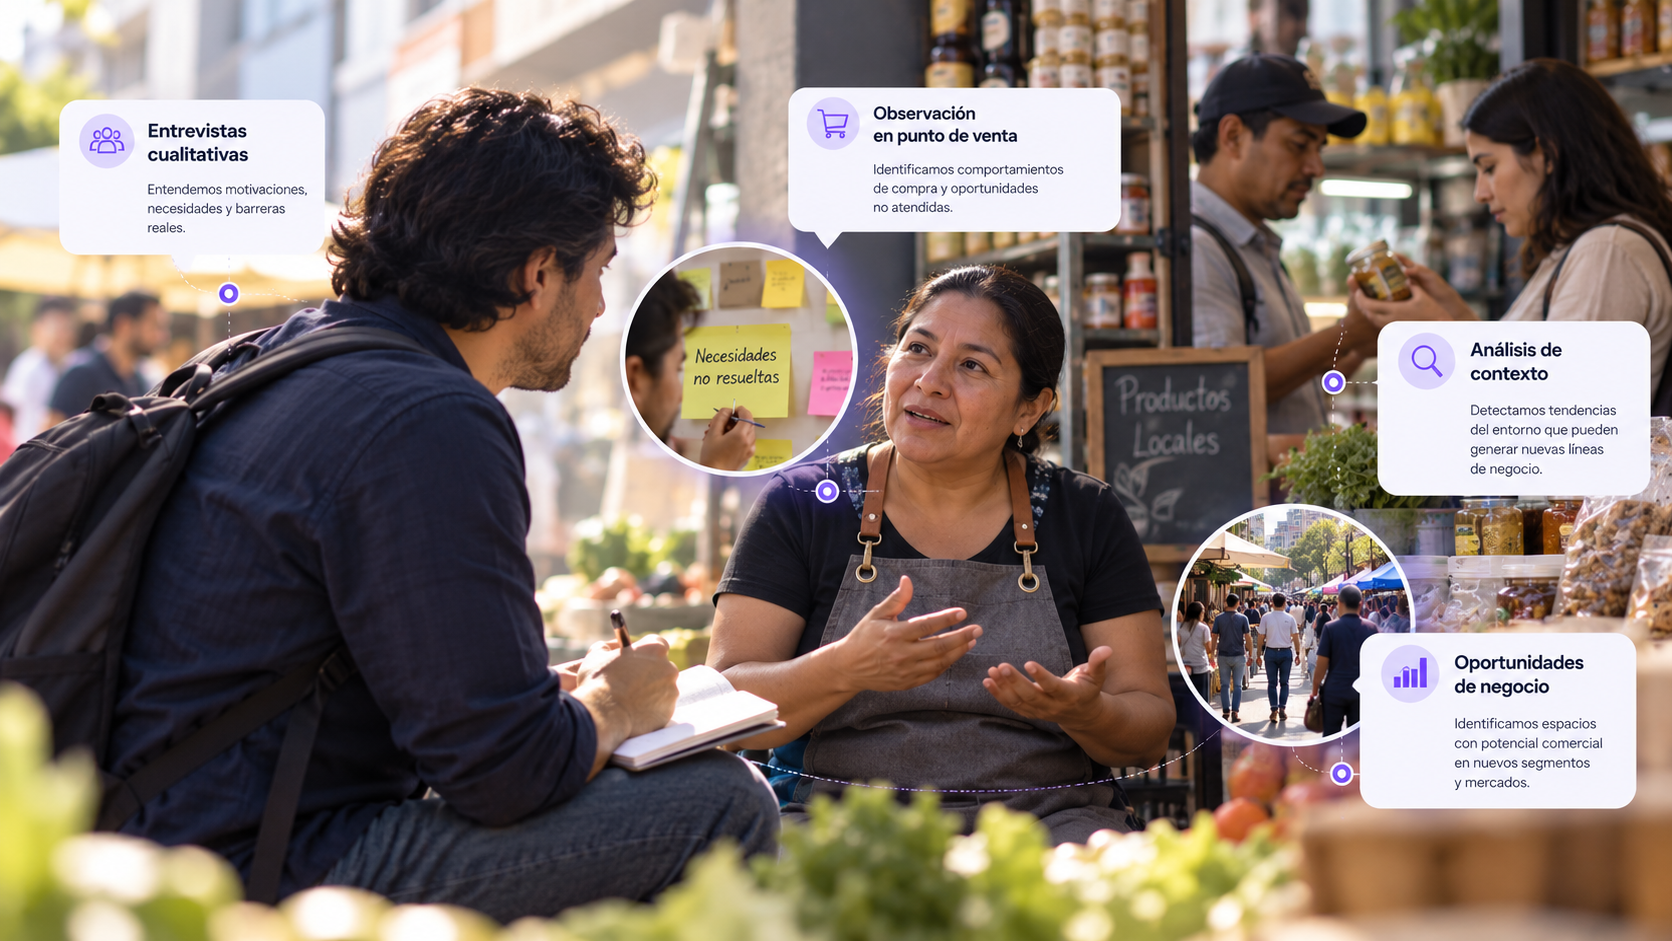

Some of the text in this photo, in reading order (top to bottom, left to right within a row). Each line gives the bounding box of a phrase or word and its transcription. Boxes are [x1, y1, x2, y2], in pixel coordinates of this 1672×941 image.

[694, 346, 777, 364] Necesidades
[693, 368, 780, 385] no resueltas
[1115, 375, 1231, 414] Productos
[1133, 419, 1220, 458] Locales
